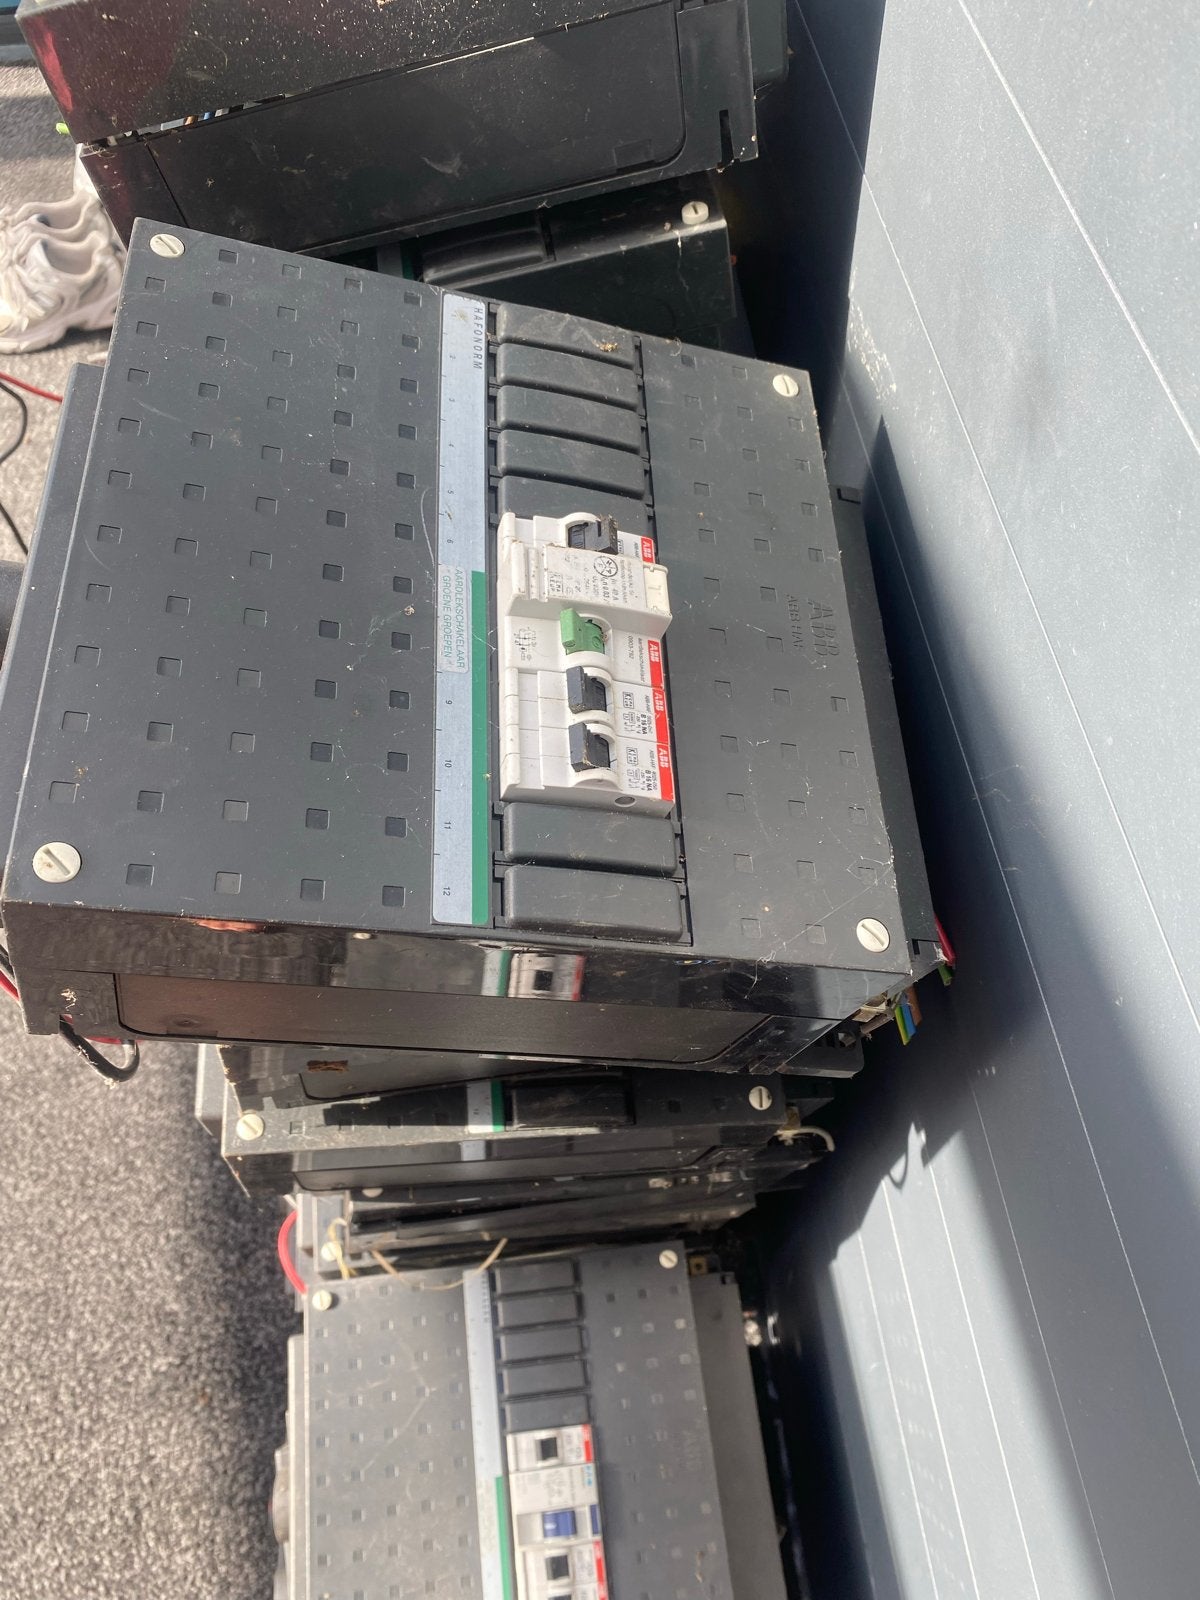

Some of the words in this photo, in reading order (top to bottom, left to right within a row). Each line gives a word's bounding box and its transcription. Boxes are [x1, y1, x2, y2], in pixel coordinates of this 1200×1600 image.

[473, 308, 483, 369] HAFONORM
[642, 541, 652, 558] ABB
[443, 576, 452, 611] GROENE
[455, 569, 465, 668] AARDLEKSCHAKELAAR
[807, 599, 840, 657] ABB
[443, 614, 452, 657] GROEPEN
[650, 644, 659, 662] ABB
[655, 692, 664, 711] ABB
[444, 759, 452, 768] 10
[659, 748, 668, 768] ABB
[444, 821, 451, 830] 11
[443, 886, 451, 896] 12
